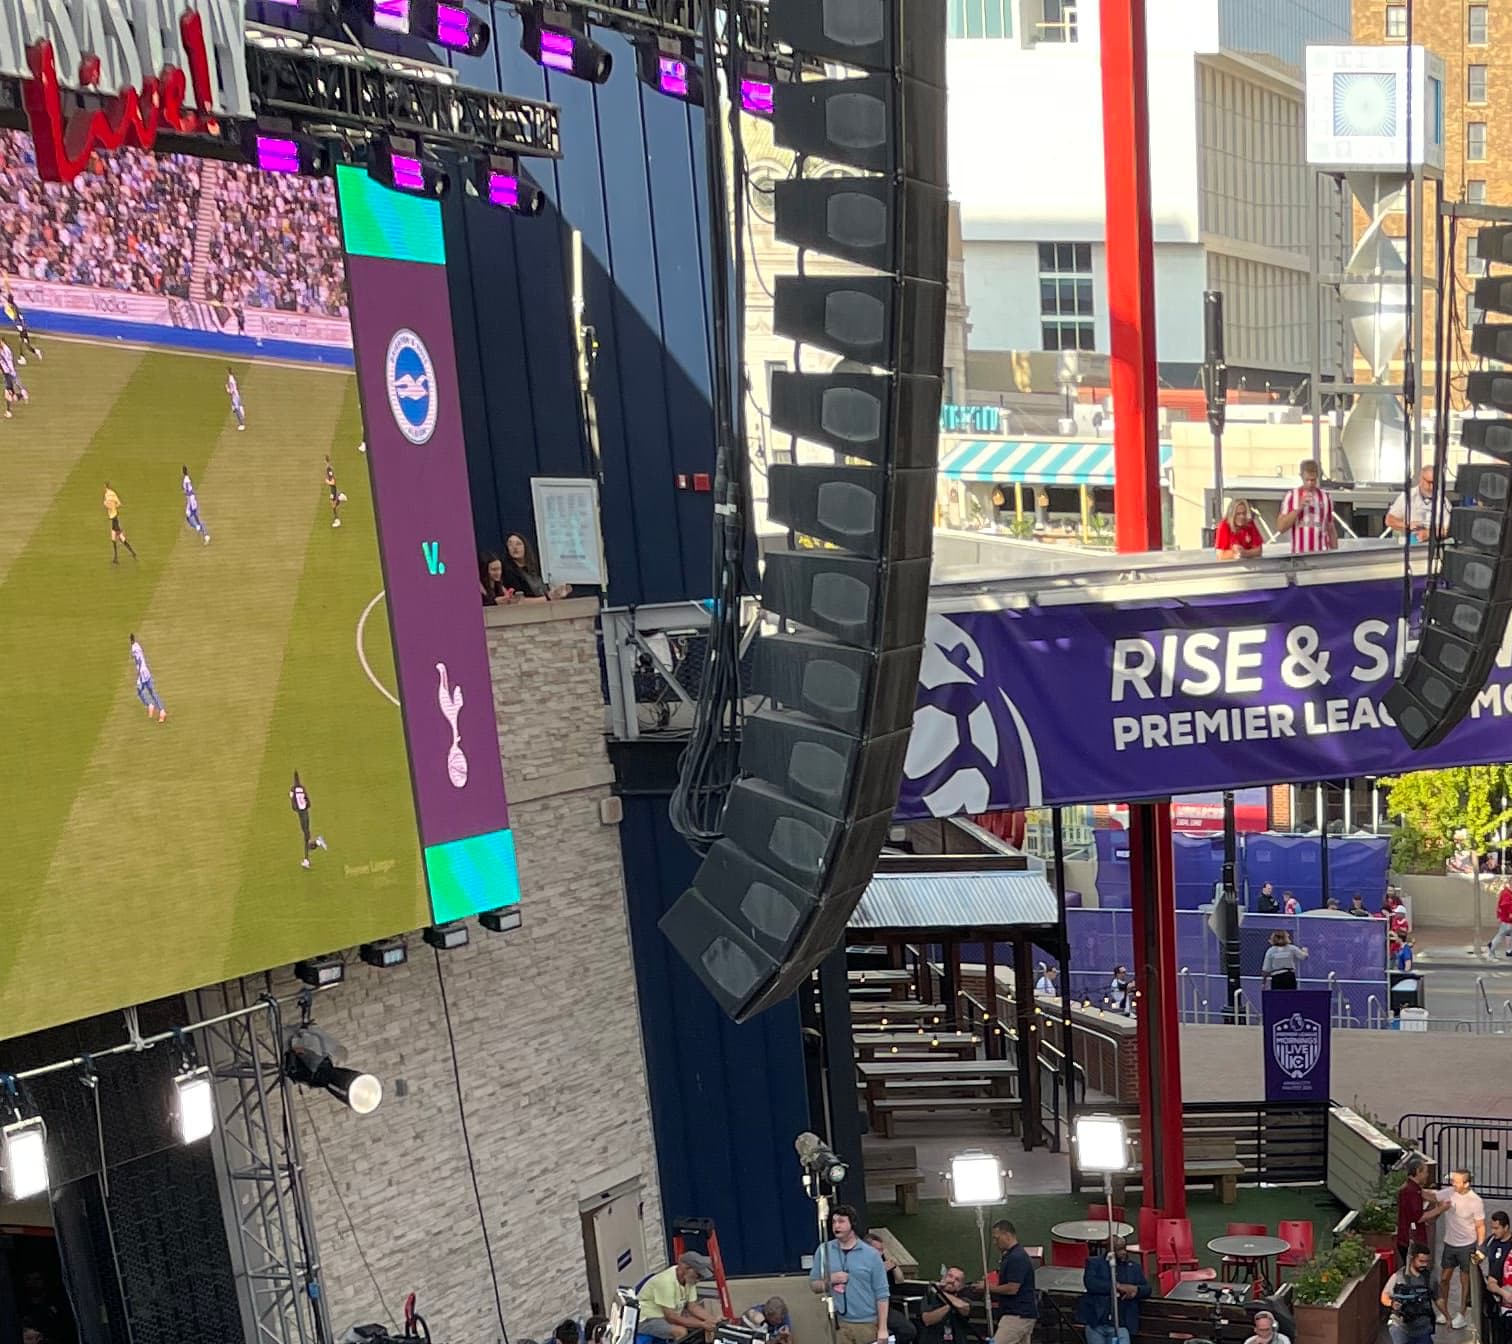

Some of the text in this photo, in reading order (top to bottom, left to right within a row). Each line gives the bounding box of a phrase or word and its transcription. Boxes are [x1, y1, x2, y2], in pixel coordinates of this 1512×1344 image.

[1111, 629, 1267, 701] RISE
[1280, 625, 1332, 689] &
[1113, 704, 1297, 751] PREMIER
[1287, 1044, 1309, 1054] LIVE
